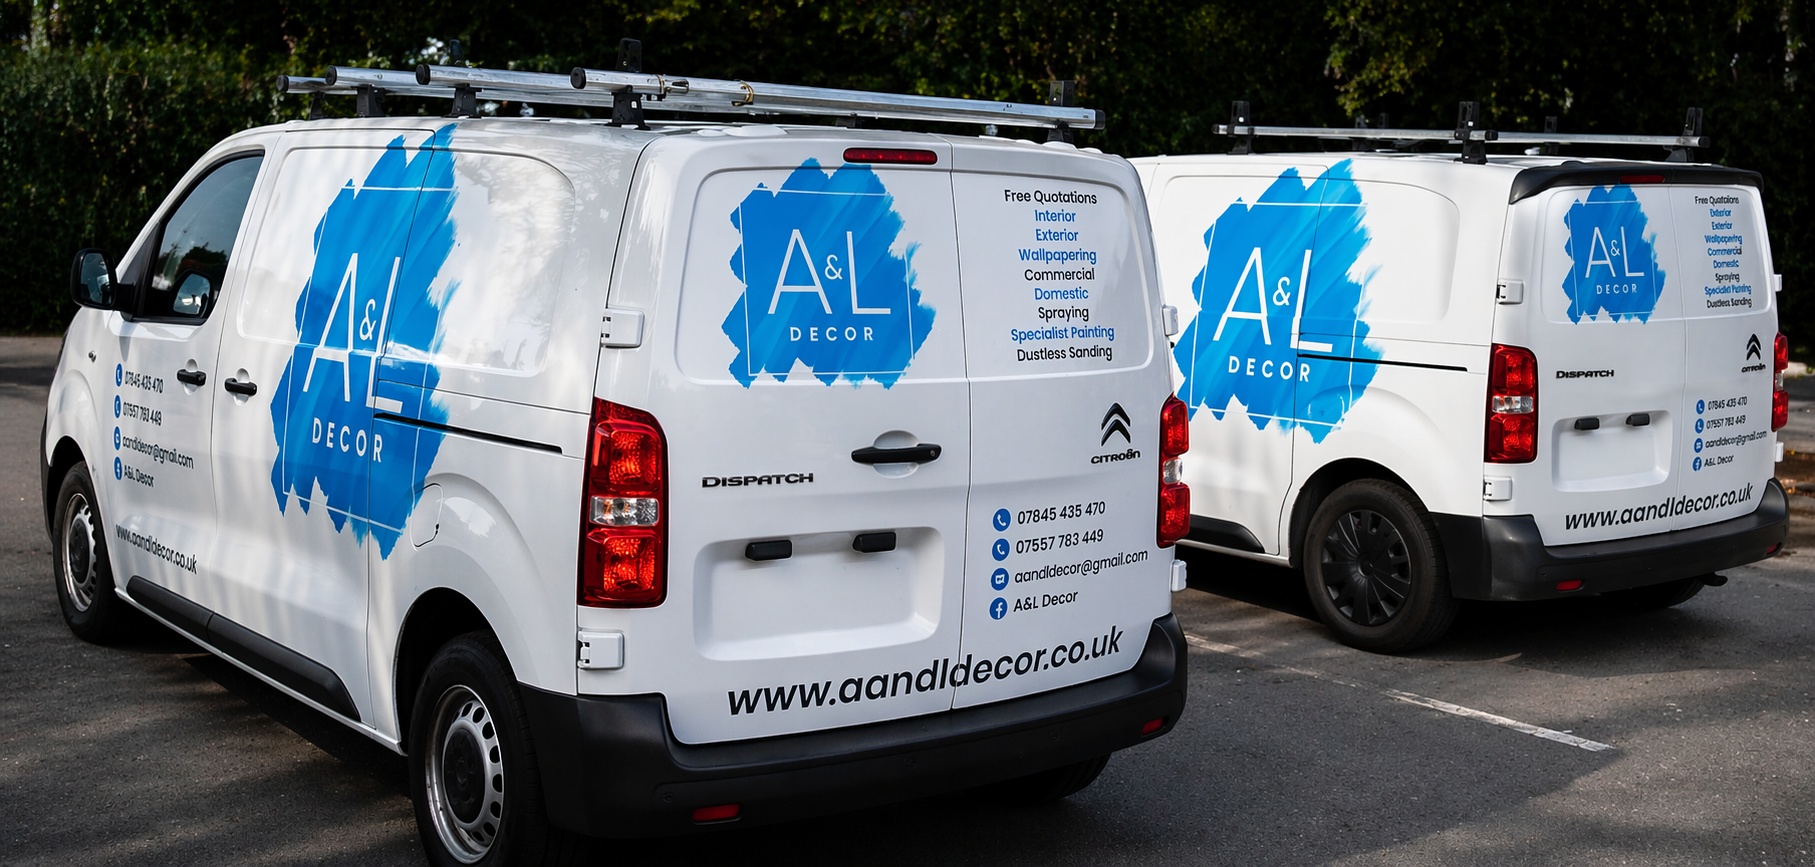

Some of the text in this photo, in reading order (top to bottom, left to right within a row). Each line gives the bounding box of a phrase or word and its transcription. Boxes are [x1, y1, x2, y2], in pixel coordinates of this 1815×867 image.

[1004, 189, 1097, 205] Free Quotations
[1694, 195, 1708, 204] Free
[1034, 209, 1076, 222] Interior
[1036, 228, 1078, 241] Exterior
[1018, 248, 1097, 265] Wallpapering
[1585, 226, 1645, 278] A&L
[768, 229, 891, 314] A&L
[1024, 268, 1095, 281] Commercial
[1715, 272, 1740, 283] Spraying
[1034, 287, 1089, 300] Domestic
[1596, 284, 1638, 295] DECOR
[1213, 247, 1333, 352] A&L
[1038, 306, 1089, 322] Spraying
[303, 252, 404, 413] A&L
[790, 326, 874, 341] DECOR
[1011, 325, 1115, 344] Specialist Painting
[1017, 345, 1113, 361] Dustless Sanding
[1228, 356, 1310, 382] DECOR
[312, 418, 383, 463] DECOR
[1017, 501, 1106, 525] 07845 435 470
[1565, 482, 1753, 530] www.aandldecor.co.uk
[1015, 528, 1104, 554] 07557 783 449
[1014, 550, 1148, 583] aandldecor@gmail.com
[1013, 591, 1078, 612] A&L Decor
[727, 625, 1124, 716] www.aandldecor.co.uk
